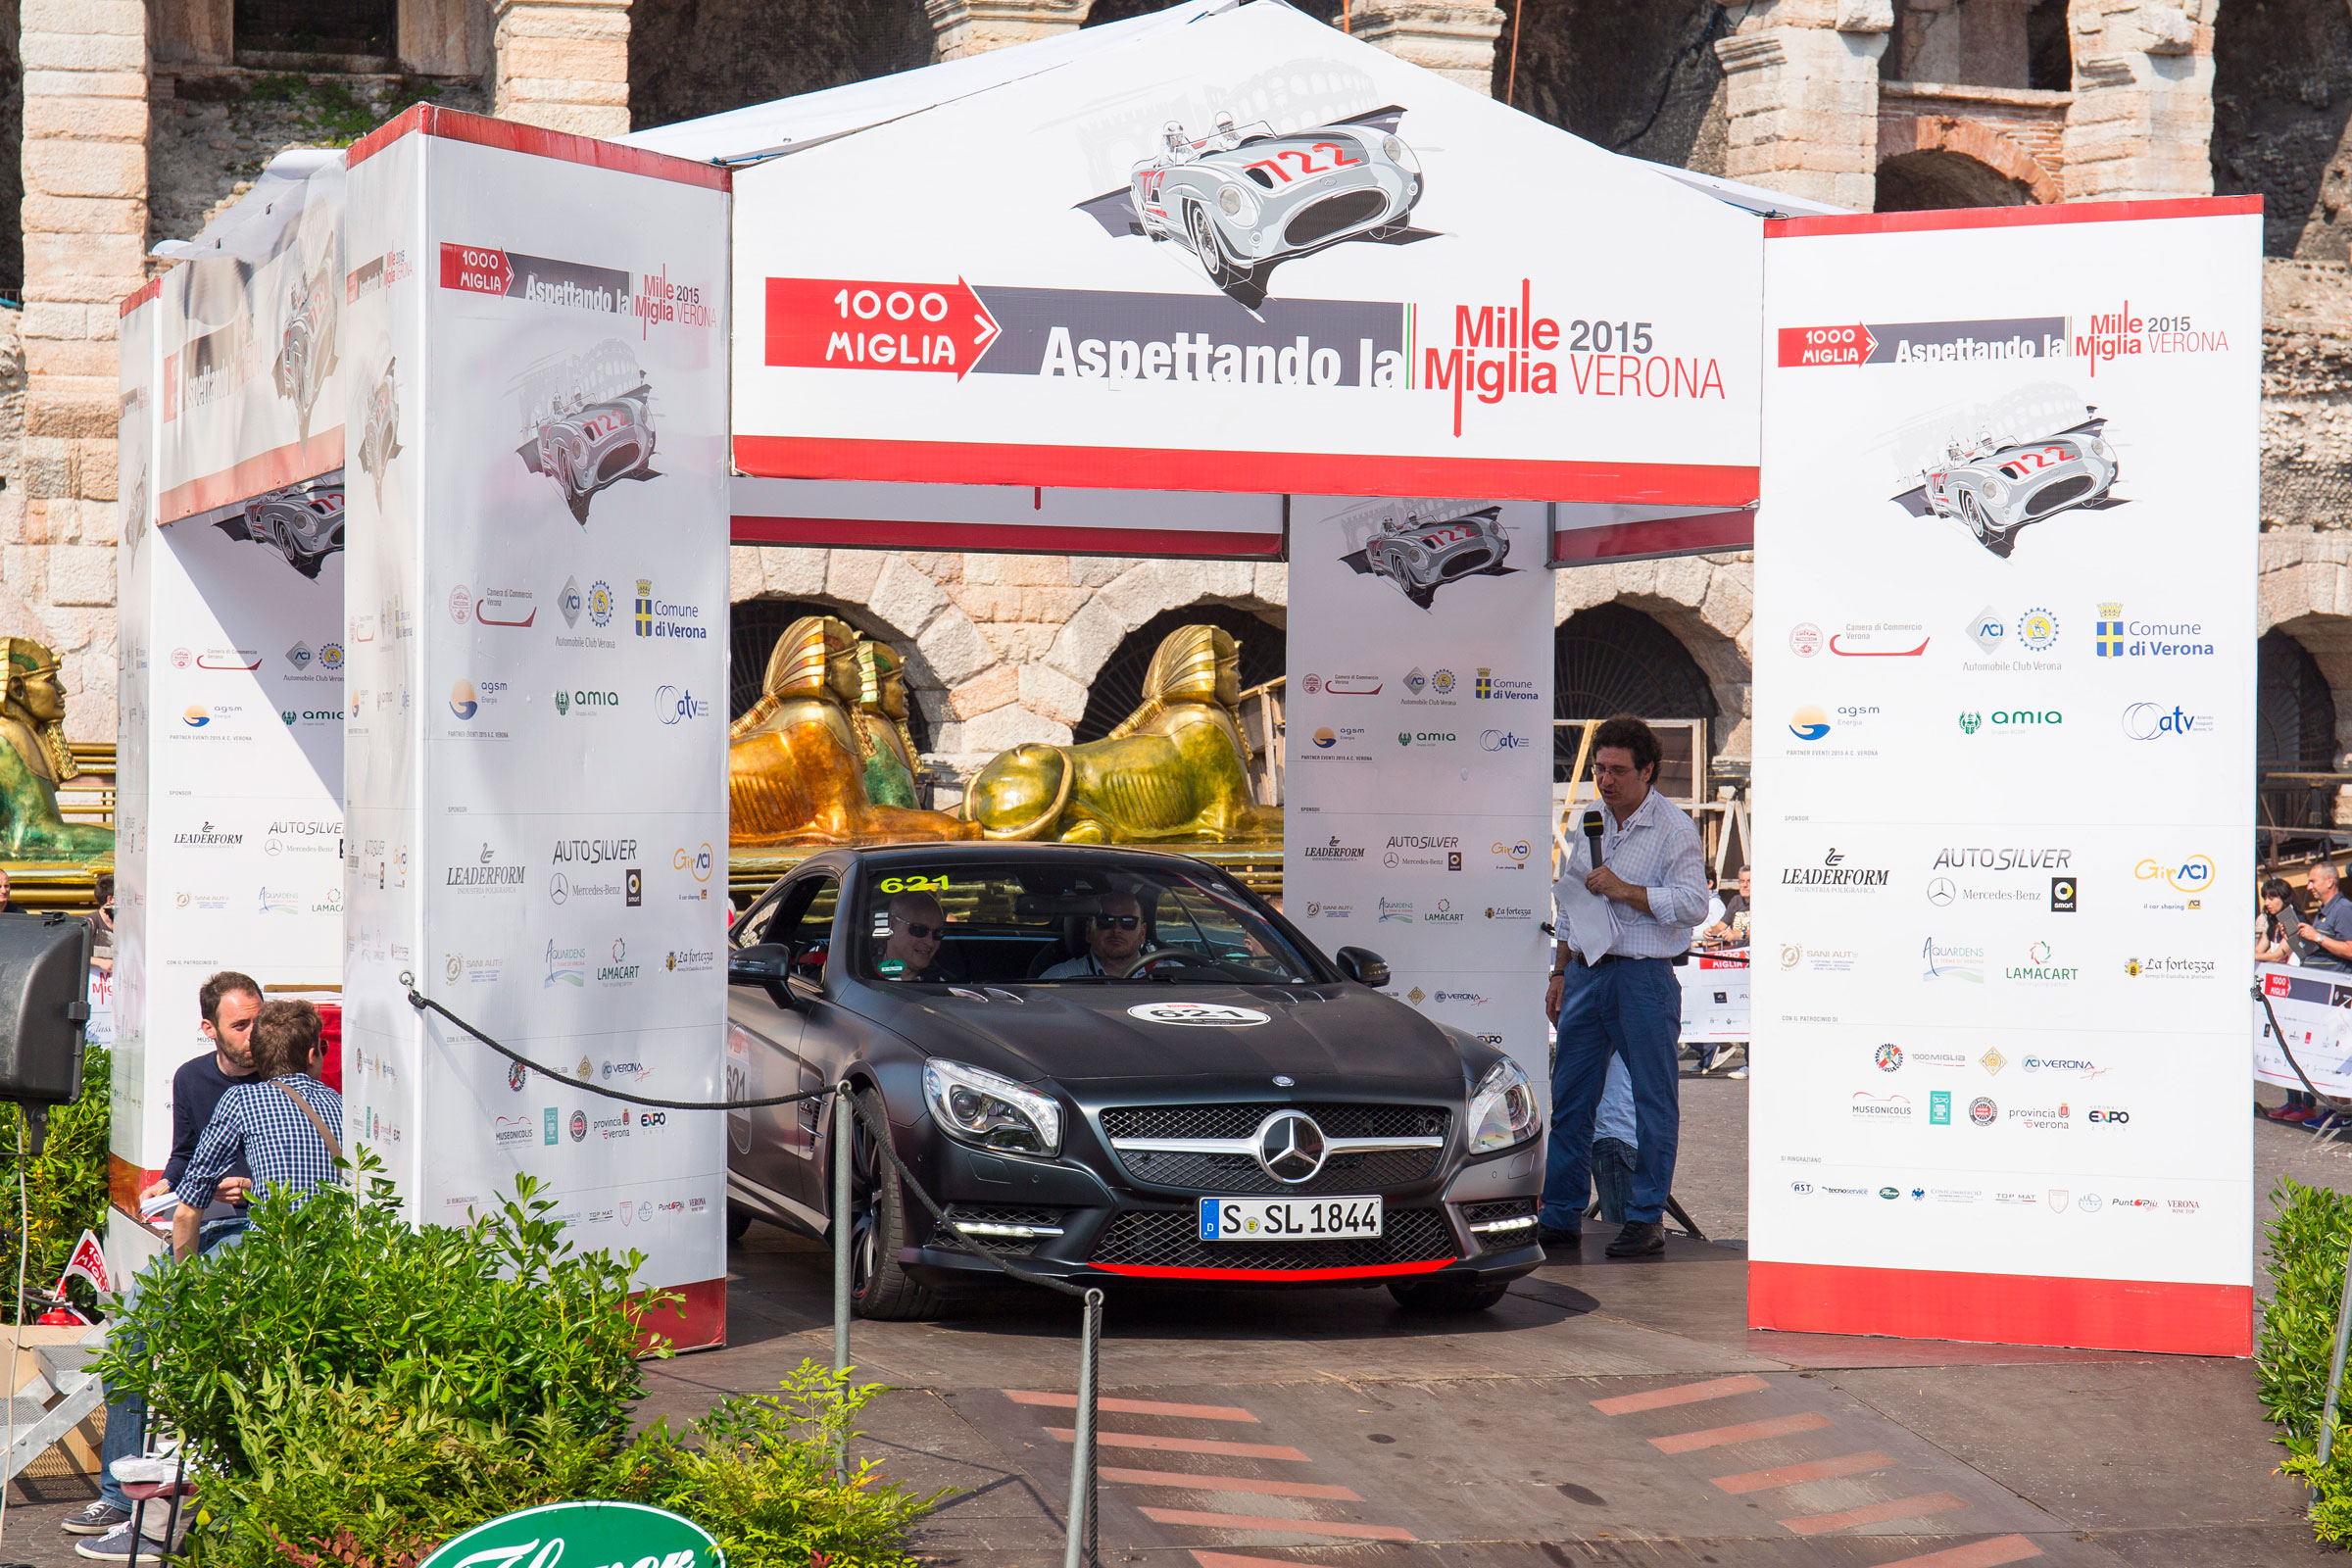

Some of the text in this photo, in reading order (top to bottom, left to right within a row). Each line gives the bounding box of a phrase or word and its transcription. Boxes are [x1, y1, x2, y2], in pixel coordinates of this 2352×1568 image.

[1242, 142, 1361, 183] 722
[463, 250, 499, 270] 1000
[461, 271, 501, 292] MIGLIA
[644, 263, 674, 300] Mille
[525, 273, 629, 315] Aspettando la
[676, 285, 700, 305] 2015
[834, 289, 948, 321] 1000
[635, 295, 673, 341] Miglia
[677, 302, 717, 328] VERONA
[1455, 277, 1560, 351] Mille
[2090, 300, 2143, 334] Mille
[2147, 317, 2191, 333] 2015
[1569, 319, 1653, 354] 2015
[1806, 329, 1855, 344] 1000
[2148, 331, 2230, 354] VERONA
[825, 331, 956, 366] MIGLIA
[1802, 347, 1858, 364] MIGLIA
[1894, 334, 2065, 365] Aspettando la
[2076, 334, 2142, 377] Miglia
[1039, 325, 1403, 391] Aspettando la
[1570, 353, 1725, 400] VERONA
[1424, 347, 1557, 438] Miglia
[582, 409, 631, 442] 722
[1997, 445, 2078, 476] 722
[1421, 525, 1479, 546] 722
[565, 595, 580, 610] ACI
[655, 600, 699, 618] Comune
[655, 622, 707, 639] di Verona
[1980, 623, 2004, 637] ACI
[2129, 621, 2202, 636] Comune
[555, 636, 615, 649] Automobile Club Verona
[2129, 641, 2214, 656] di Verona
[295, 652, 310, 661] ACI
[1963, 661, 2062, 671] Automobile Club Verona
[481, 681, 508, 694] agsm
[1410, 676, 1425, 685] ACI
[1494, 678, 1533, 689] Comune
[574, 690, 619, 706] amia
[1494, 690, 1539, 701] di Verona
[677, 689, 698, 719] atv
[1838, 706, 1880, 717] agsm
[1991, 710, 2062, 724] amia
[2159, 705, 2195, 735] atv
[1416, 731, 1456, 742] amia
[1499, 731, 1519, 749] atv
[269, 821, 344, 835] AUTOSILVE
[173, 833, 243, 844] LEADERFORM
[1386, 836, 1458, 849] AUTOSILVER
[553, 839, 637, 865] AUTOSILVER
[1304, 847, 1364, 858] LEADERFORM
[1933, 848, 2072, 870] AUTOSILVER
[446, 866, 525, 886] LEADERFORM
[1782, 868, 1889, 886] LEADERFORM
[572, 884, 620, 897] Mercedes-Benz
[880, 875, 950, 894] 621
[1962, 889, 2041, 901] Mercedes-Benz
[1506, 906, 1532, 915] fortezza
[677, 949, 713, 964] La fortezza
[1806, 950, 1830, 958] SANI
[2145, 956, 2215, 973] La fortezza
[597, 965, 640, 981] LAMACART
[2006, 967, 2079, 980] LAMACART
[2273, 976, 2286, 986] 1000
[92, 983, 113, 1004] Mig
[1150, 1009, 1245, 1018] 621
[612, 1062, 644, 1073] VERONA
[2041, 1059, 2094, 1069] VERONA
[726, 1064, 746, 1110] 621
[1852, 1105, 1911, 1115] MUSEONICOLIS
[2009, 1107, 2056, 1119] provincia
[2088, 1110, 2130, 1124] EXPO
[594, 1116, 621, 1132] provincia
[641, 1112, 666, 1127] EXPO
[2034, 1120, 2069, 1129] verona
[496, 1129, 533, 1141] MUSEONICOLIS
[609, 1129, 630, 1140] verona
[1794, 1183, 1811, 1192] AST
[689, 1197, 706, 1206] VERONA
[2168, 1200, 2199, 1208] VERONA
[1222, 1202, 1377, 1234] S SL 1844
[1207, 1223, 1213, 1232] D
